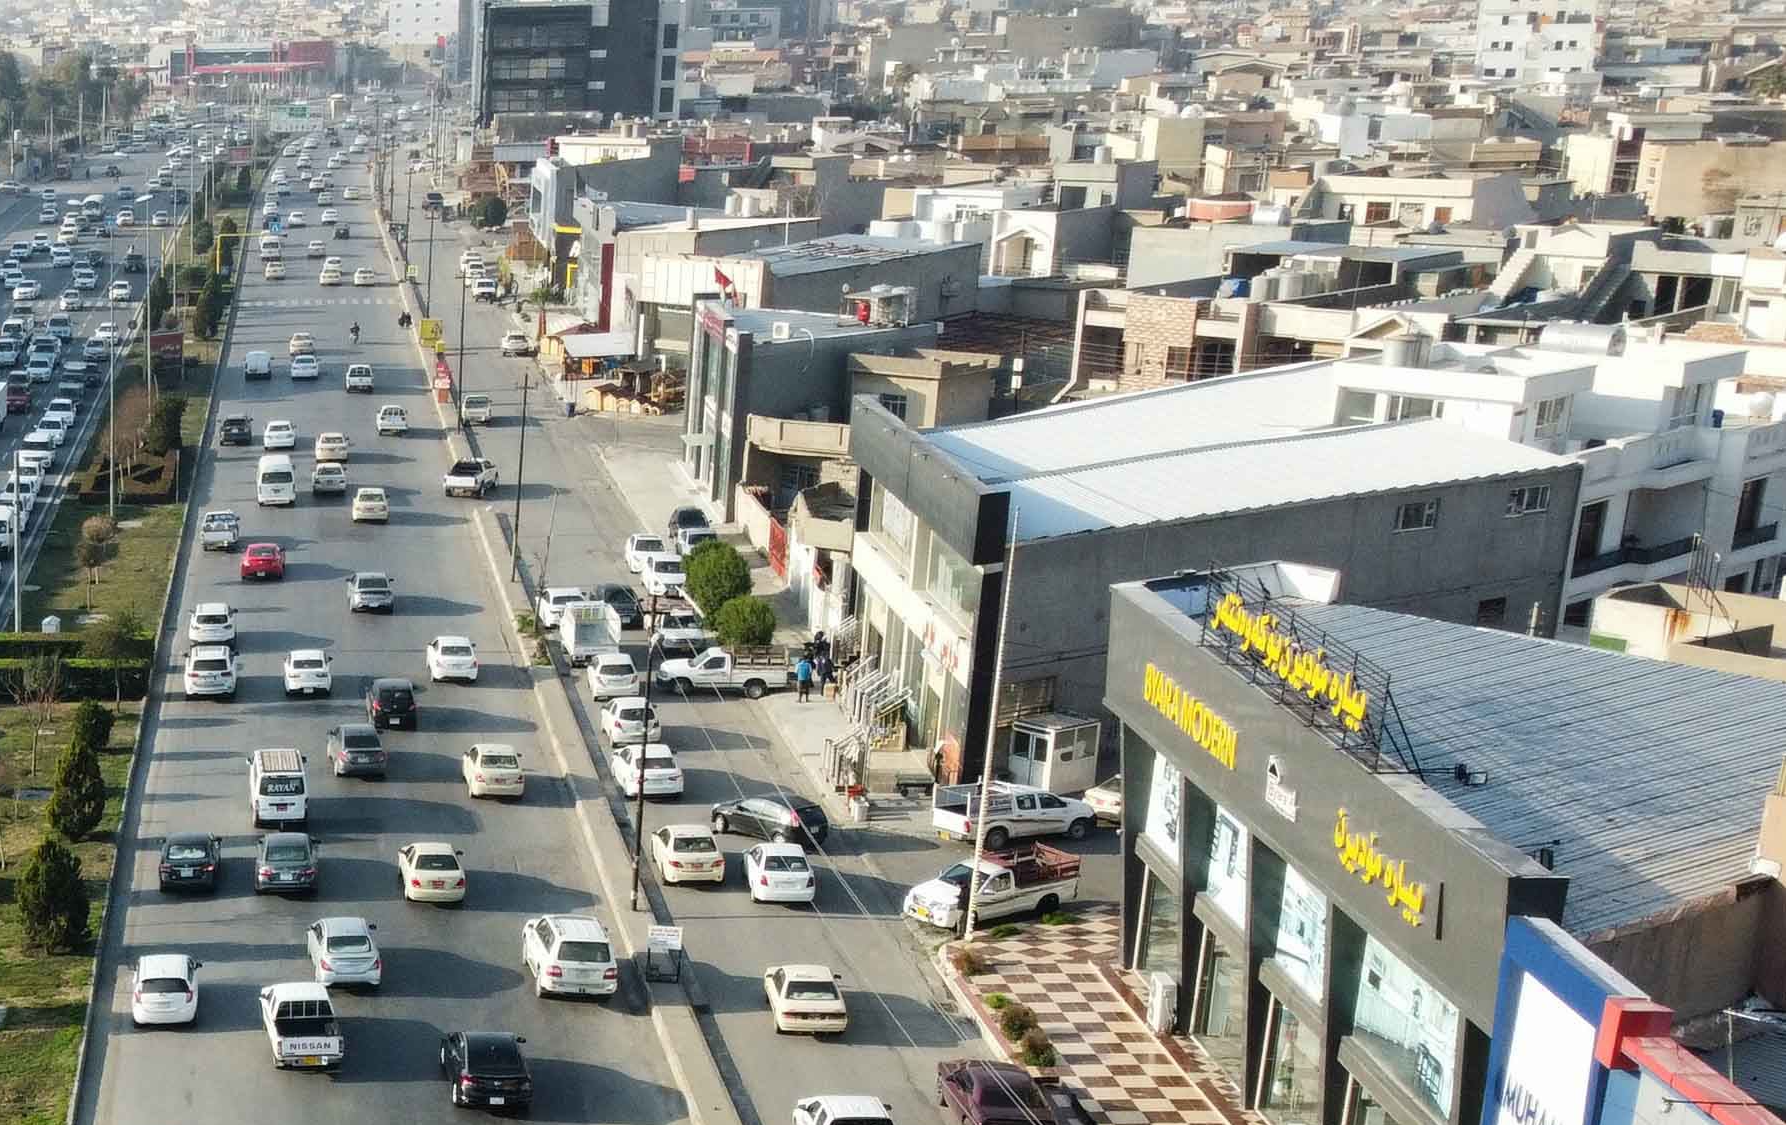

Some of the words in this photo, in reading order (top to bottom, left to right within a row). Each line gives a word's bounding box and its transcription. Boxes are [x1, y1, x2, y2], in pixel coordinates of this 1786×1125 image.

[1143, 663, 1180, 725] BYARA
[1180, 692, 1239, 770] MODERN
[267, 783, 296, 793] RAYAN
[289, 1041, 331, 1051] NISSAN
